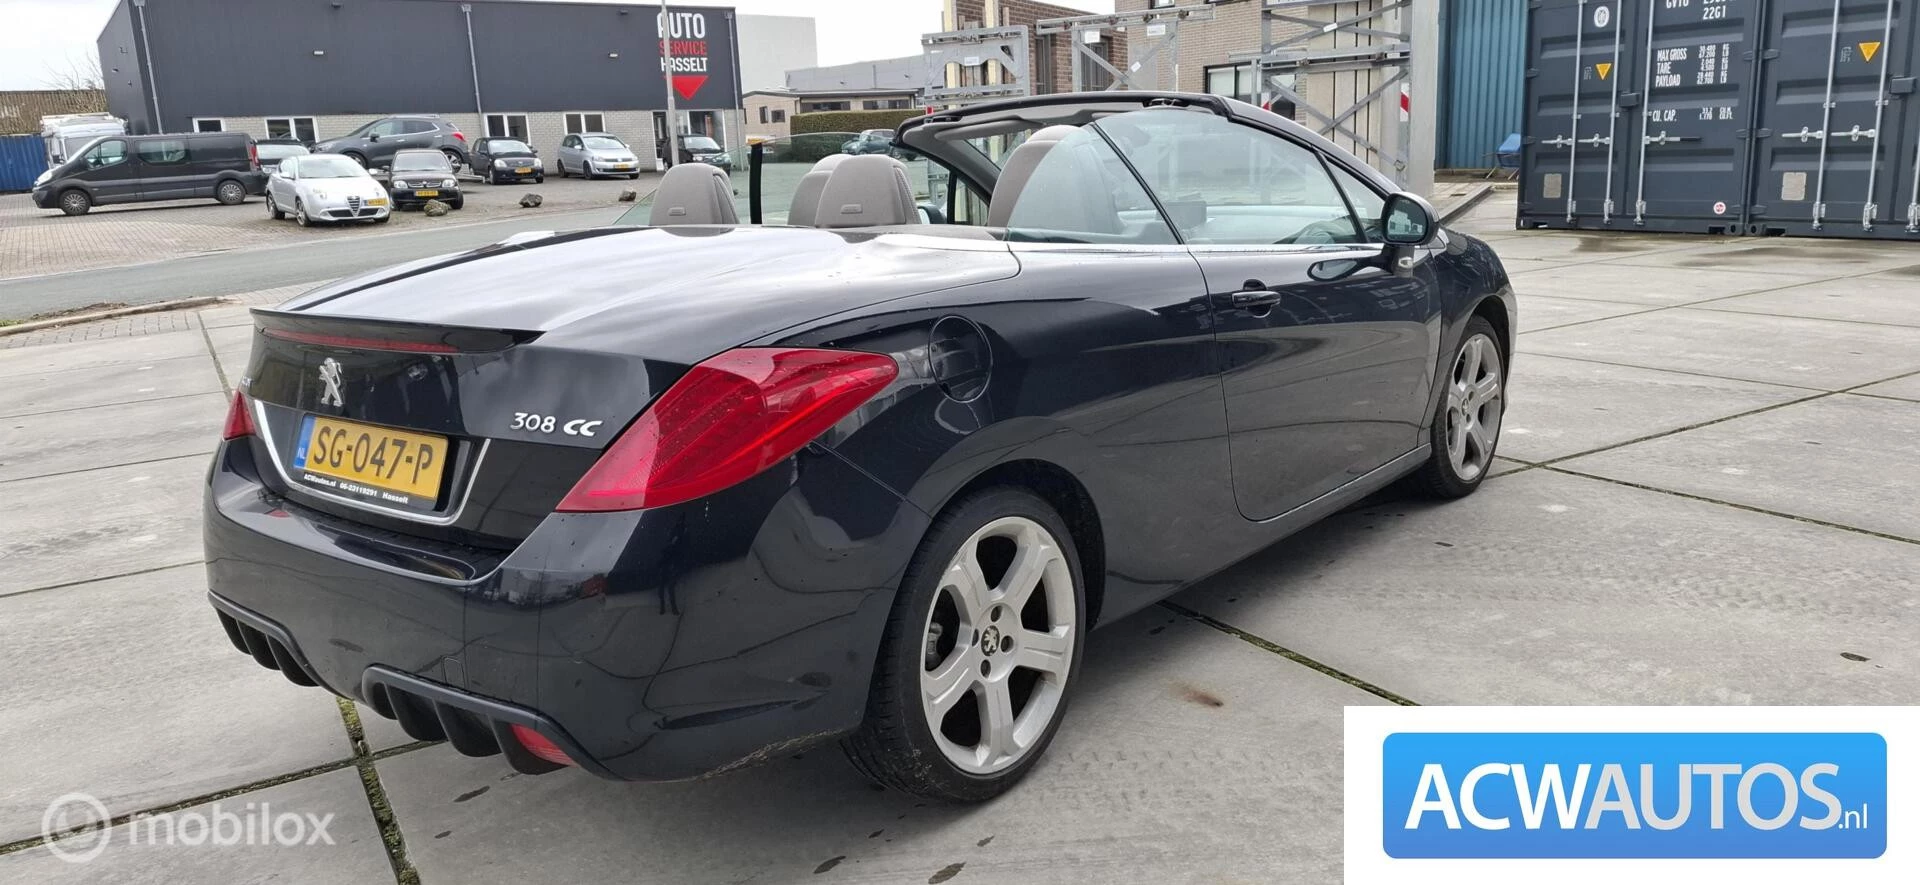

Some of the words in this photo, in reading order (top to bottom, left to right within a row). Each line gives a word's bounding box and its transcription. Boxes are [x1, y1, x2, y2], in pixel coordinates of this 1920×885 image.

[1703, 6, 1727, 20] 22G1
[657, 12, 706, 39] AUTO
[1657, 49, 1670, 62] MAX
[1670, 47, 1688, 61] GROSS
[660, 57, 708, 72] HASSELT
[1657, 61, 1672, 75] TARE
[1655, 74, 1681, 88] PAYLOAD
[1663, 109, 1677, 122] CAP.
[510, 412, 556, 433] 308
[563, 419, 603, 437] CC
[297, 447, 305, 459] NL
[313, 426, 433, 485] SG-047-P
[382, 491, 409, 504] Hasselt
